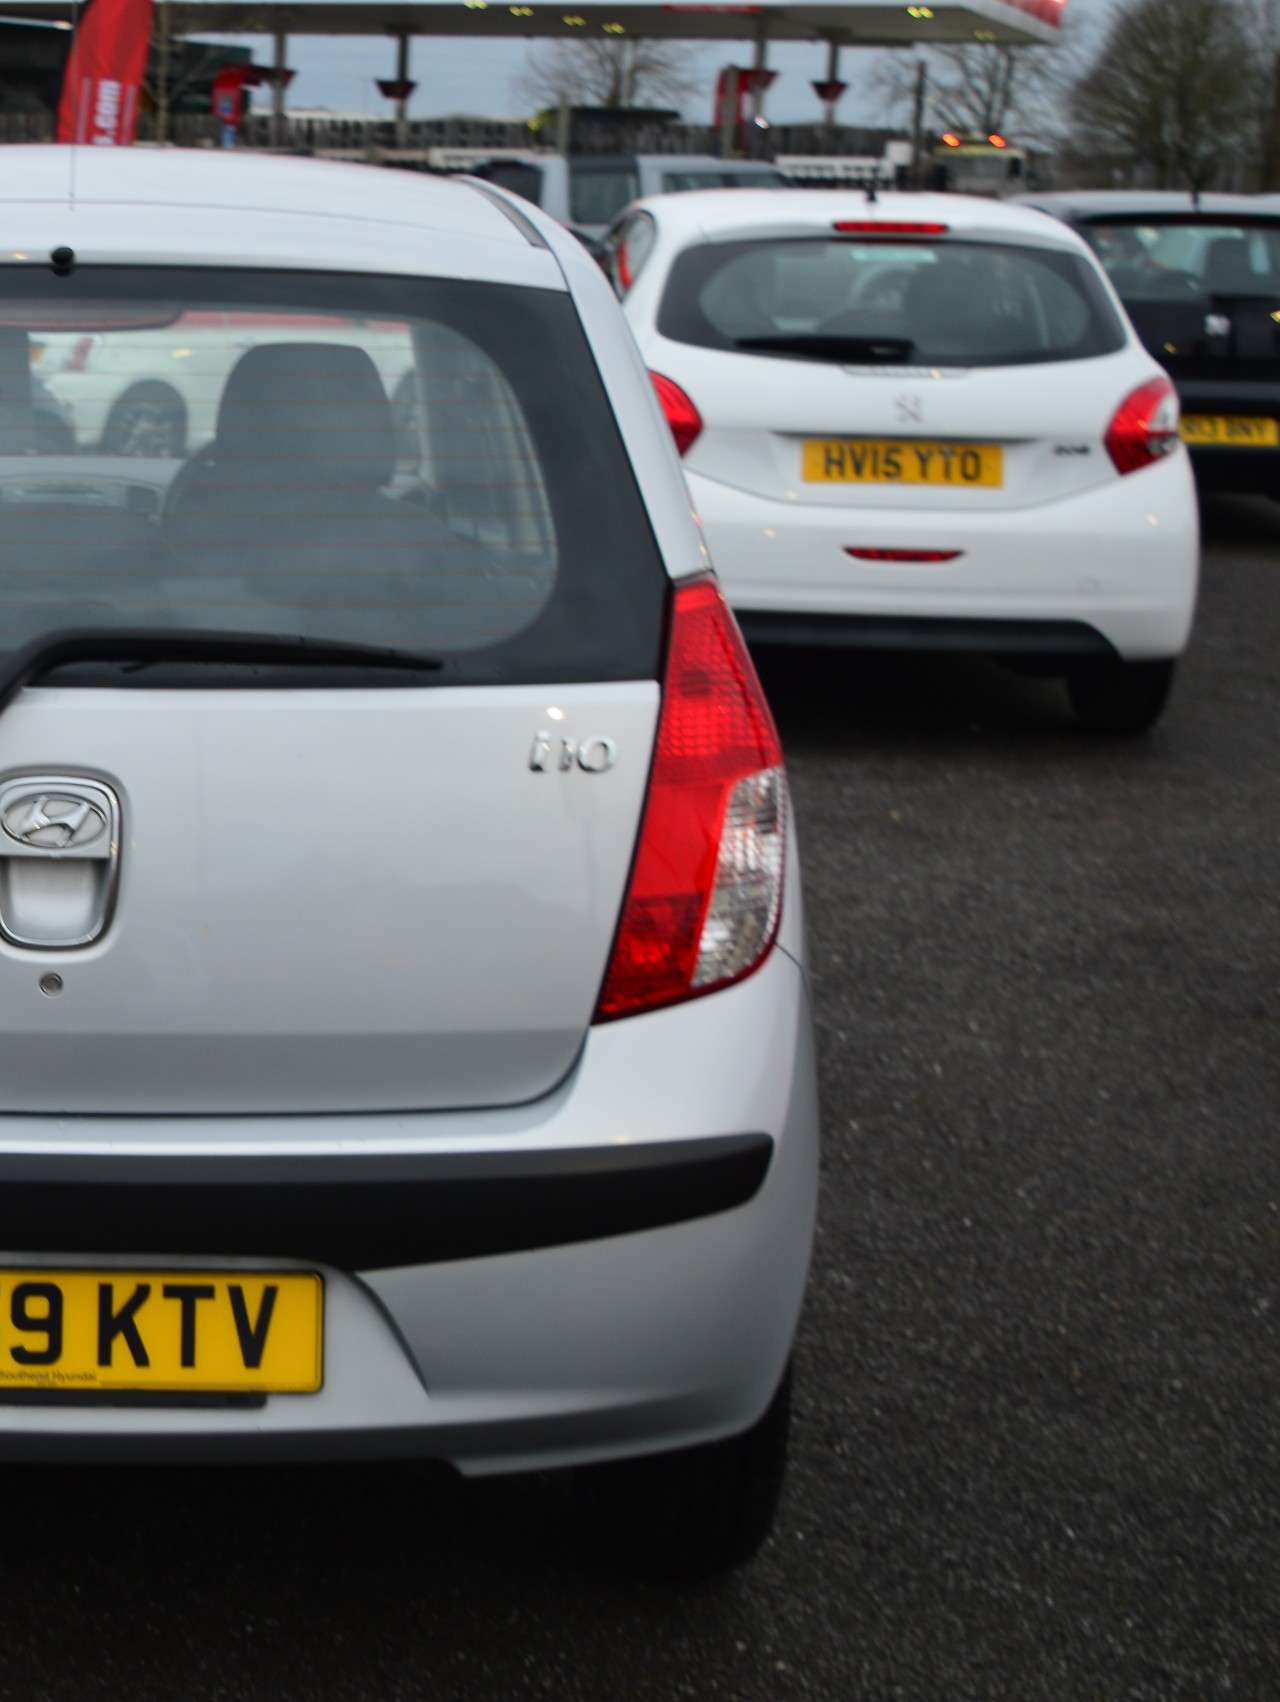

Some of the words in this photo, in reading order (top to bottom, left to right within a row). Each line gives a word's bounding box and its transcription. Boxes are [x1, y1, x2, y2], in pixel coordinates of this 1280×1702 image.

[824, 447, 903, 478] HV15
[914, 449, 982, 481] YTO
[528, 730, 617, 774] i10
[96, 1283, 279, 1369] KTV
